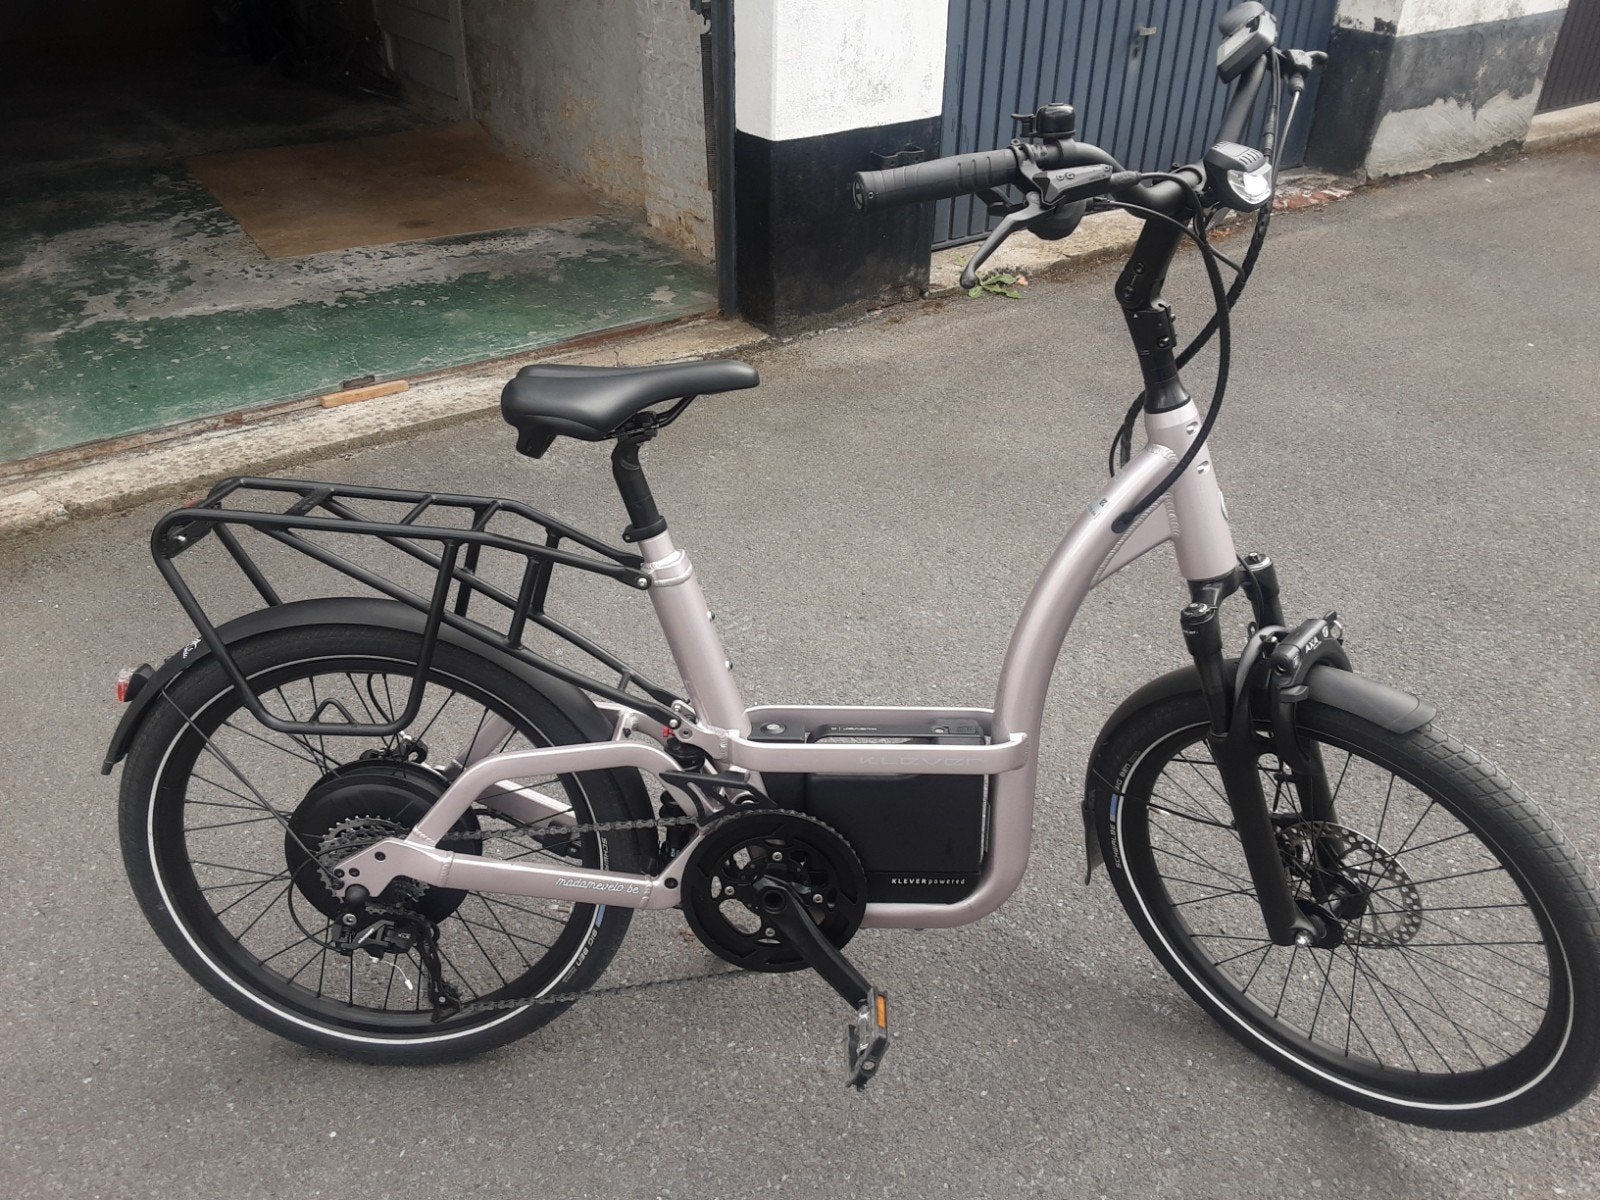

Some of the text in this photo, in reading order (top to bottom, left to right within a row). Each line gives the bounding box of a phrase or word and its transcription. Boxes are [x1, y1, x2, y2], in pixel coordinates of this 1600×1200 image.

[1305, 636, 1319, 653] AXA
[1109, 823, 1121, 869] SCHWALBE
[555, 877, 640, 894] madamevelo.be
[575, 928, 598, 967] BIG BEN
